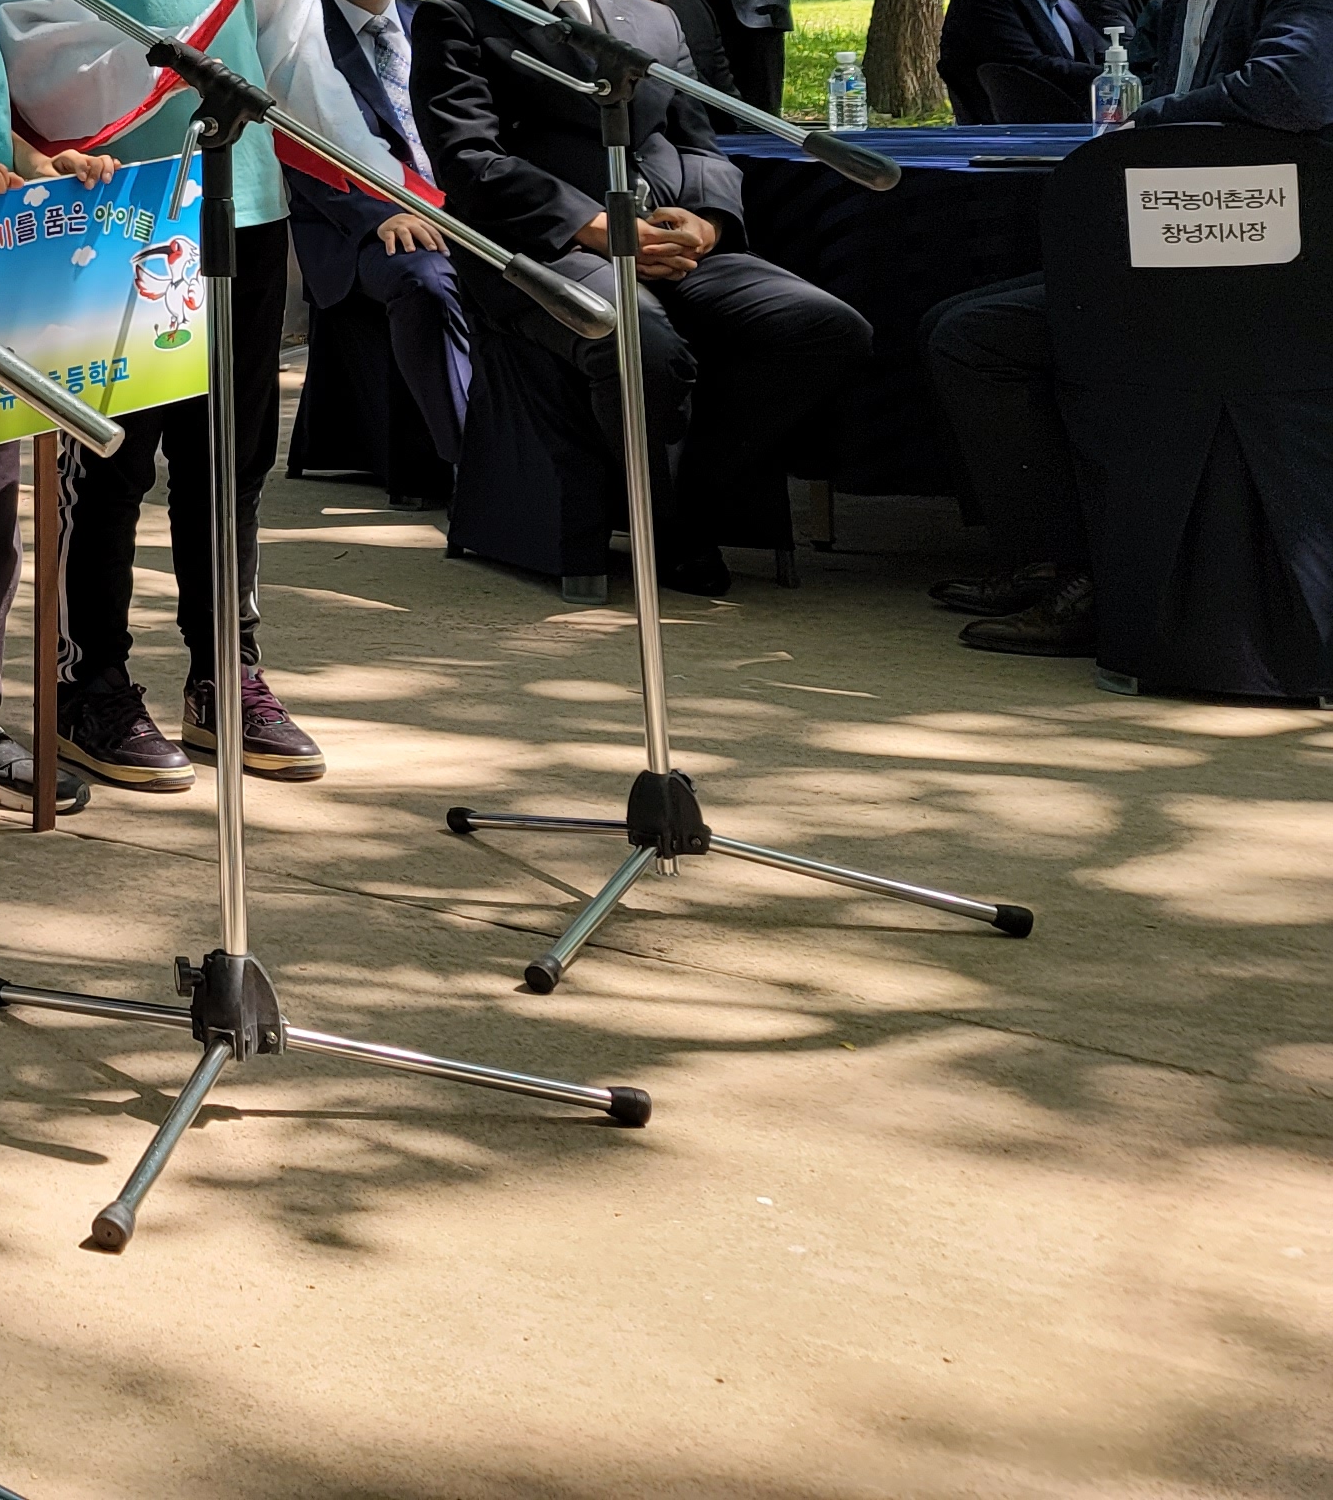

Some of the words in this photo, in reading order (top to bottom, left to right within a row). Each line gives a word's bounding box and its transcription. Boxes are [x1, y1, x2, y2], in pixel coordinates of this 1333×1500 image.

[1139, 186, 1287, 211] 한국농어촌공사
[44, 201, 88, 240] 품은
[94, 201, 156, 244] 아이들
[1161, 221, 1267, 244] 창녕지사장
